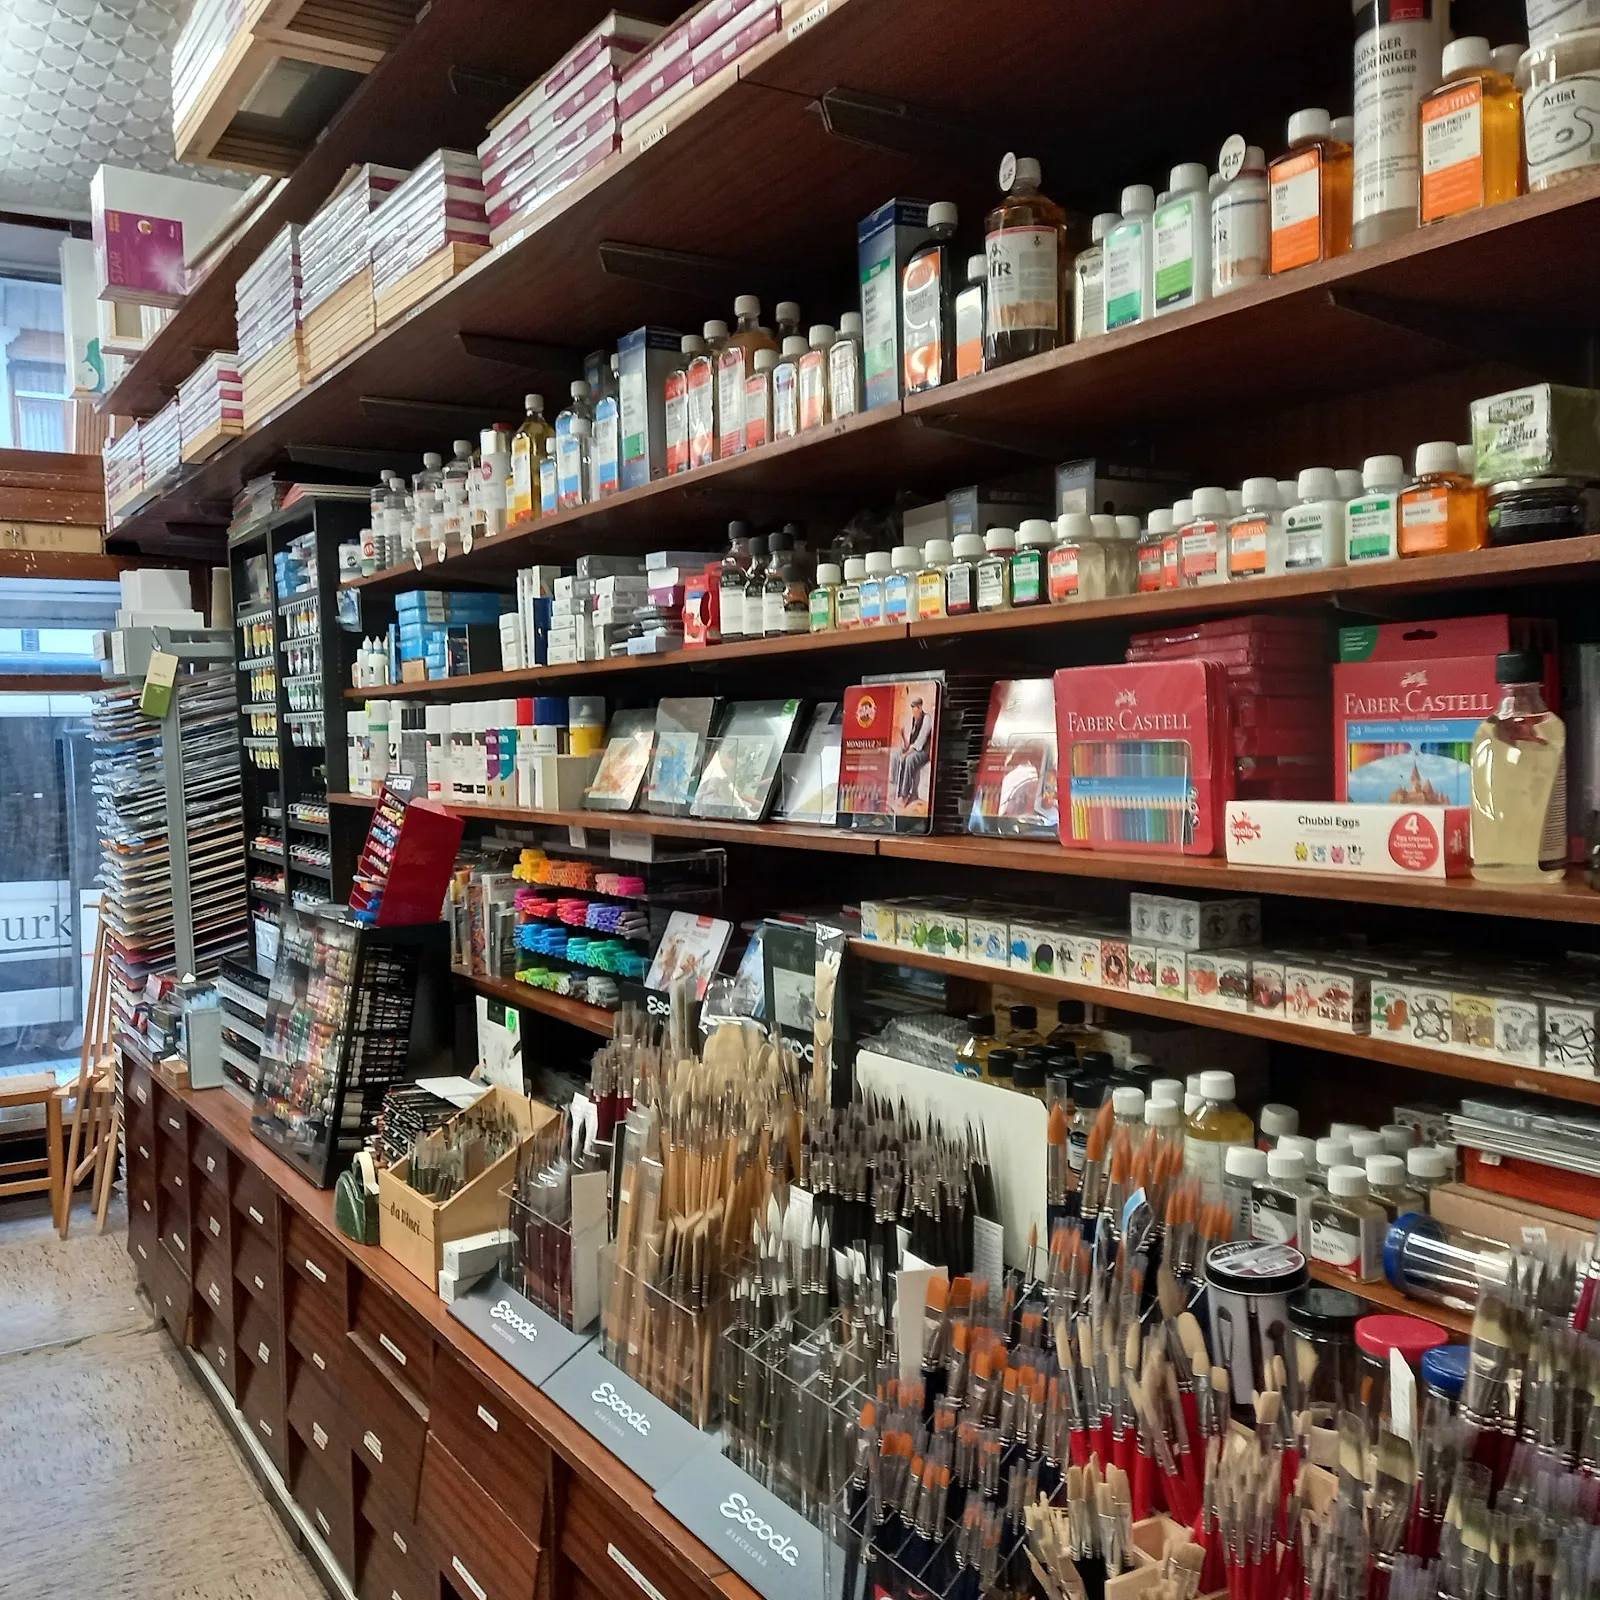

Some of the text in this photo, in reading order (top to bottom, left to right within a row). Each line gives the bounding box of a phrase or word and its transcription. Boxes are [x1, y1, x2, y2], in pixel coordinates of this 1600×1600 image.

[1542, 88, 1577, 108] Artist
[1344, 690, 1494, 714] FABER-CASTELL
[1067, 709, 1192, 732] FABER-CASTELL
[1424, 723, 1449, 733] Pencils
[1335, 816, 1361, 829] Eggs
[1404, 814, 1420, 835] 4
[490, 1300, 538, 1342] Escoda
[592, 1383, 650, 1436] Escoda
[720, 1492, 799, 1566] Escoda
[725, 1528, 768, 1567] BARCELONA
